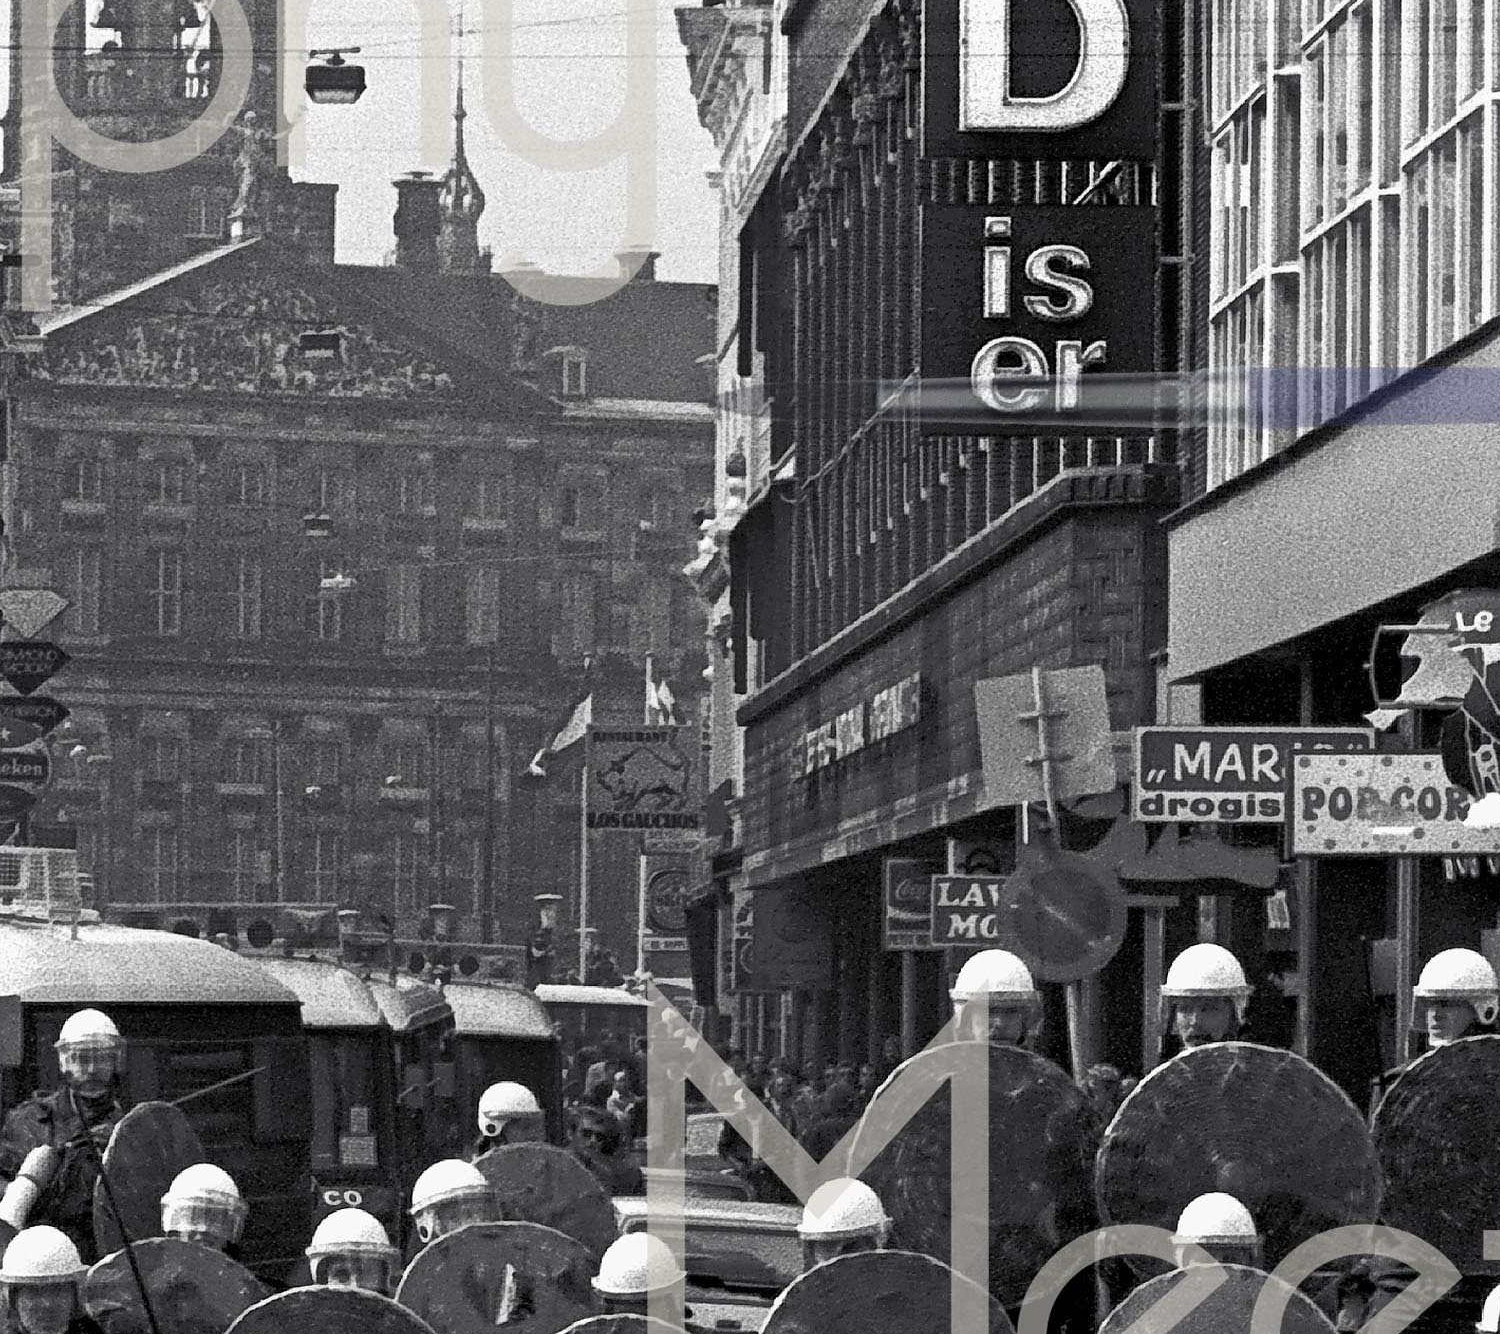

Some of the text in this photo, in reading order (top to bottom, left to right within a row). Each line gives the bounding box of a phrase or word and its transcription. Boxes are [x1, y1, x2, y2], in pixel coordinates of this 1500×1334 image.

[982, 216, 1096, 321] is
[970, 335, 1108, 414] er
[587, 812, 699, 828] LOS GAUCHOS
